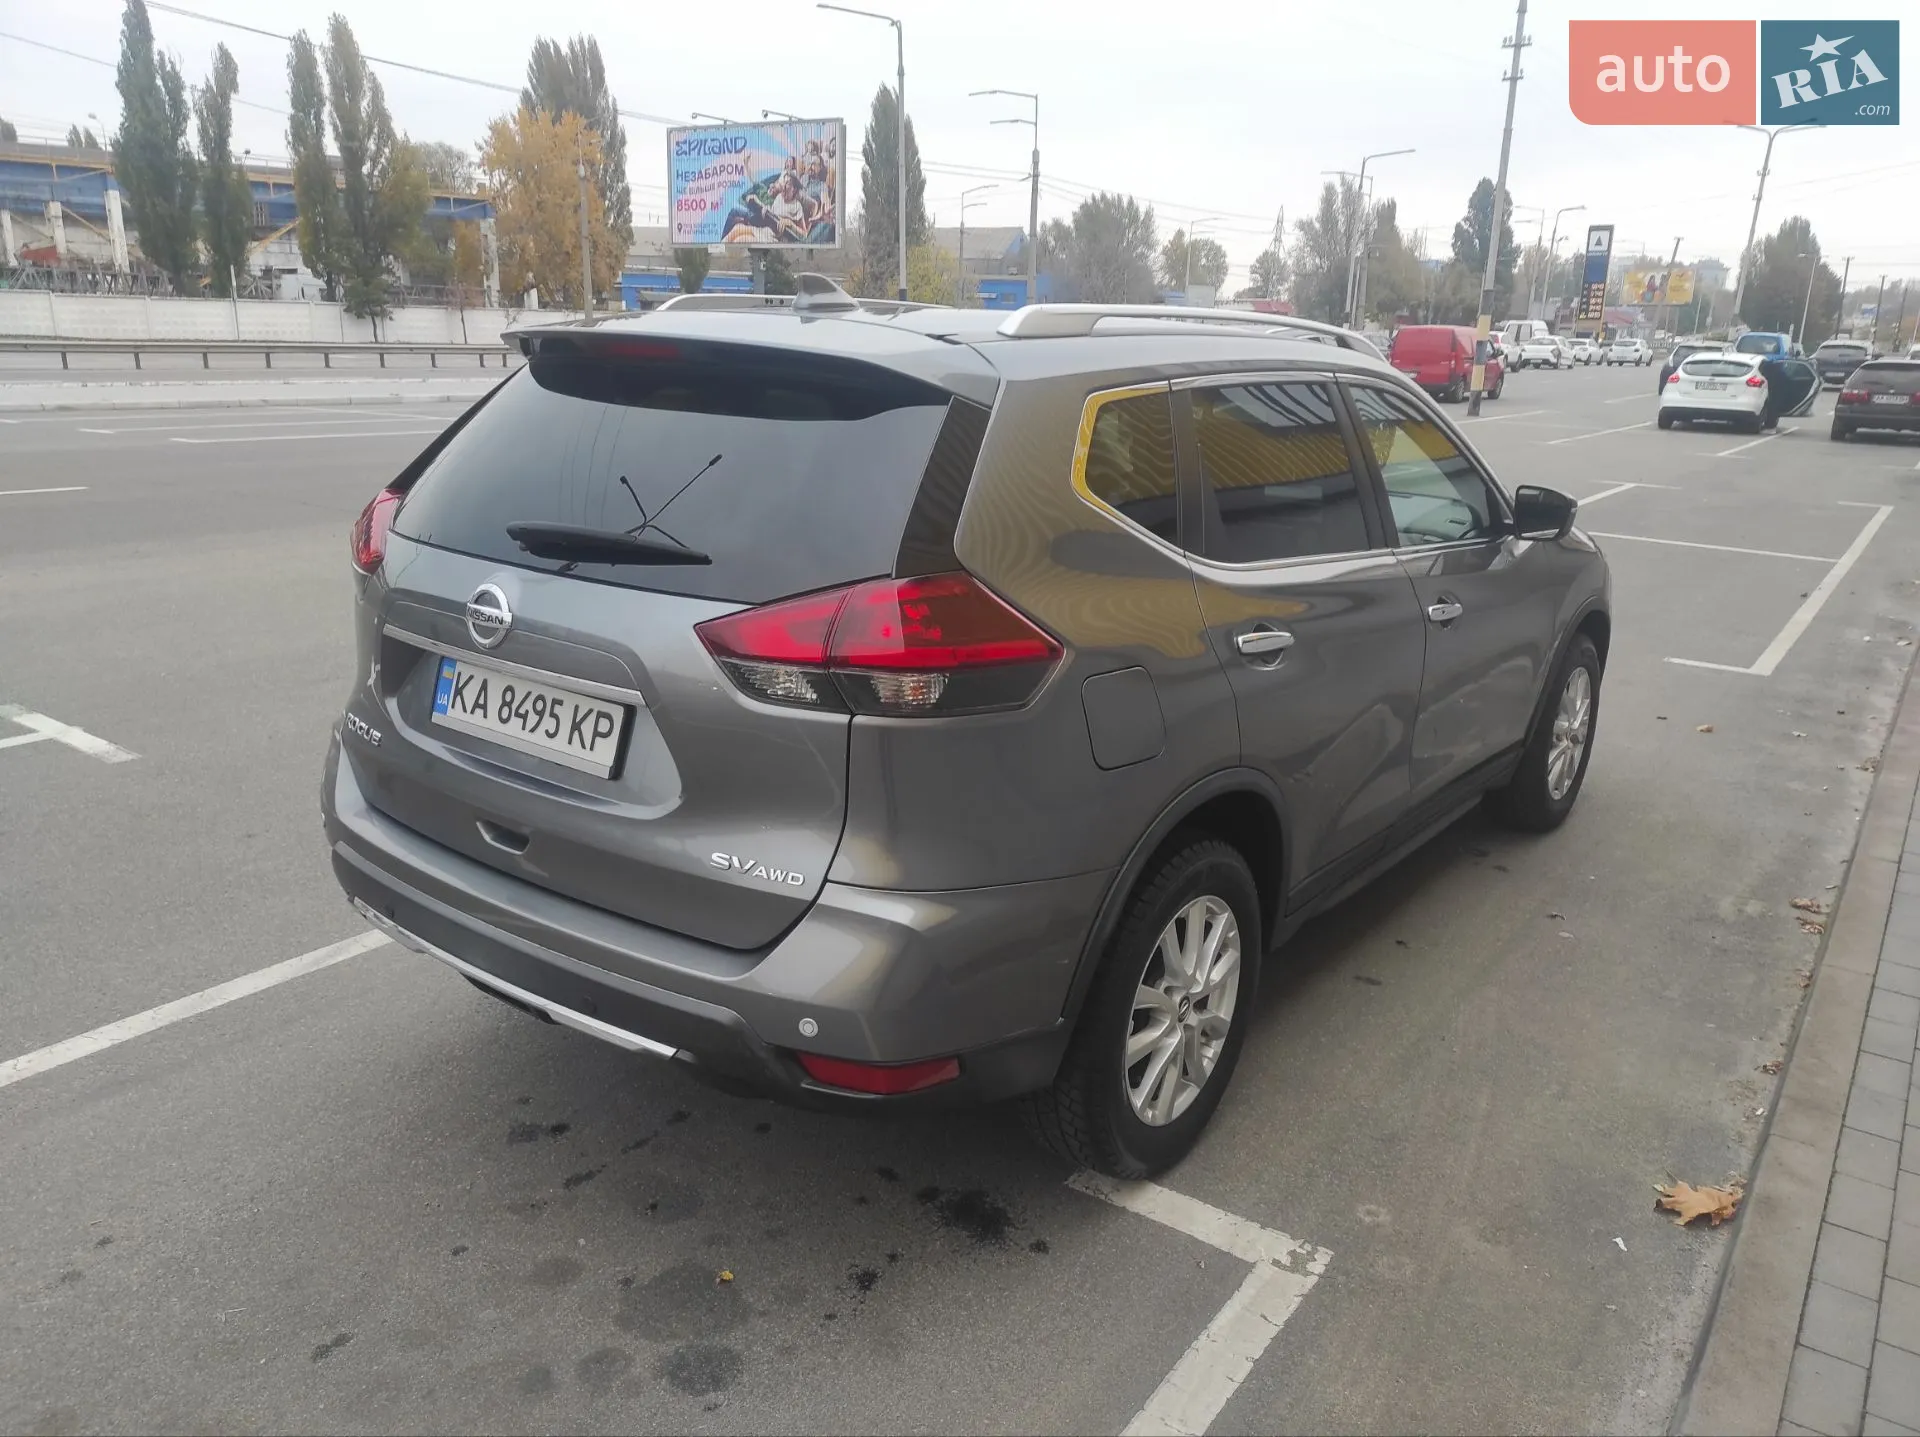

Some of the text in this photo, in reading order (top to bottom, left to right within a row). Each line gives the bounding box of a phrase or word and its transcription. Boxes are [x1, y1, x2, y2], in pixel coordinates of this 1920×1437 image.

[676, 163, 745, 183] НЕЗАБАРОМ
[676, 198, 707, 213] 8500
[467, 606, 504, 625] NISSAN
[437, 693, 448, 706] UA
[451, 671, 615, 751] KA 8495 KP
[346, 711, 382, 746] ROGUE
[710, 852, 806, 886] SV AWD
